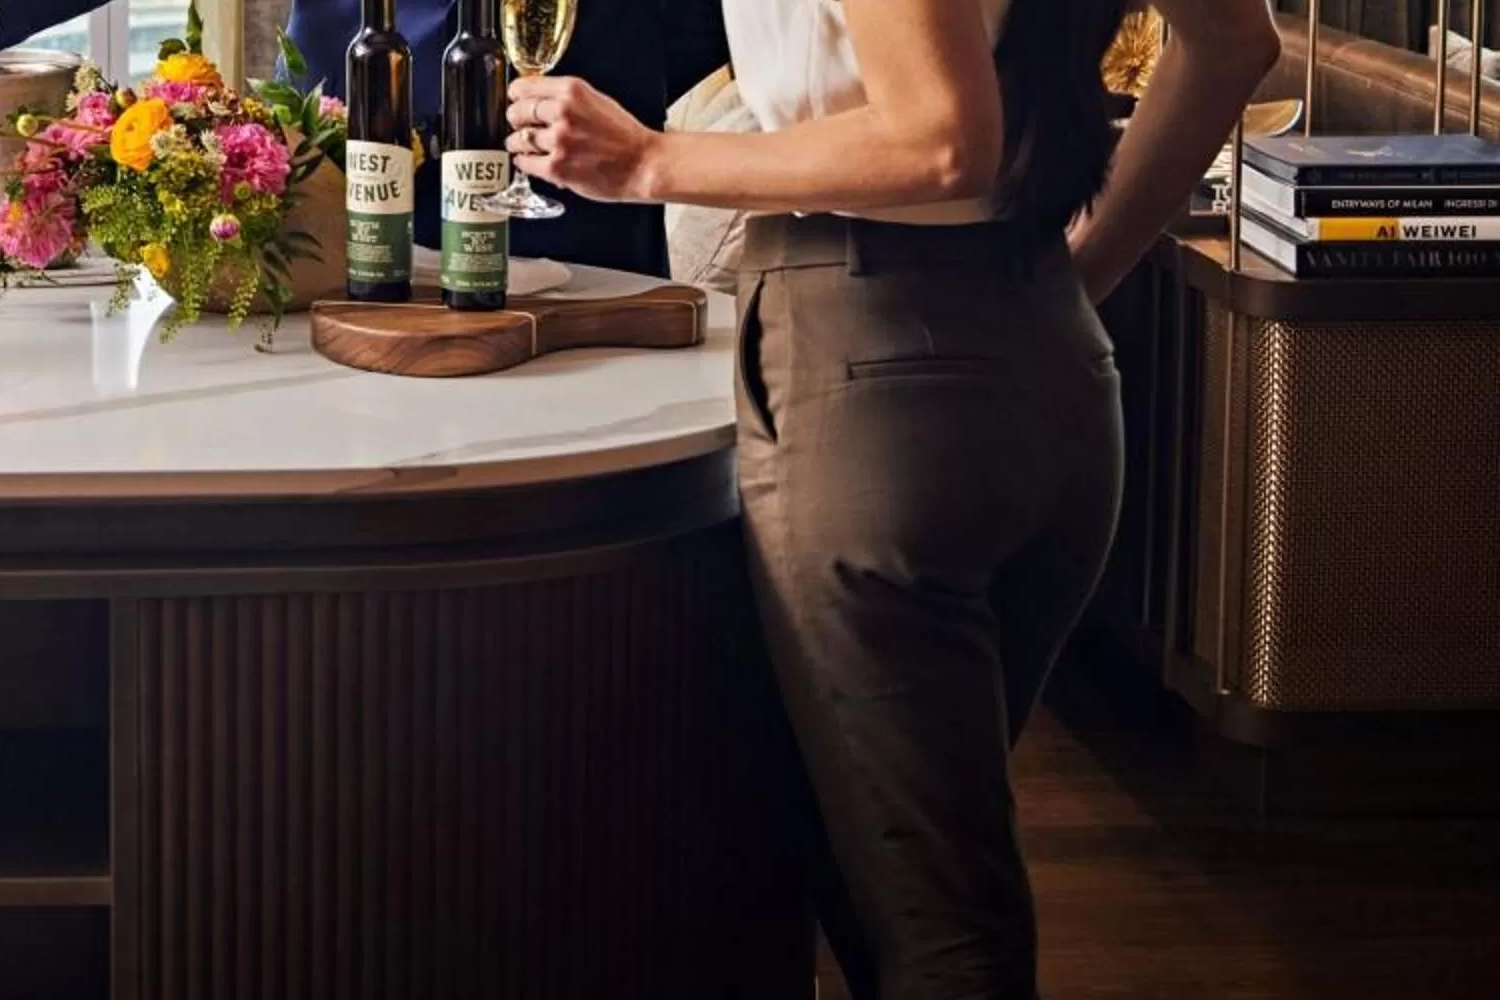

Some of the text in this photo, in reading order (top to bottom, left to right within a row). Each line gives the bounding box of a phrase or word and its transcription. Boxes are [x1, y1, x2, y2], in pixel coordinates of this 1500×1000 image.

[454, 161, 504, 181] WEST
[1331, 199, 1385, 209] ENTRYWAYS
[1387, 199, 1400, 209] OF
[1402, 199, 1433, 209] MILAN
[1377, 225, 1477, 238] AI WEIWEI
